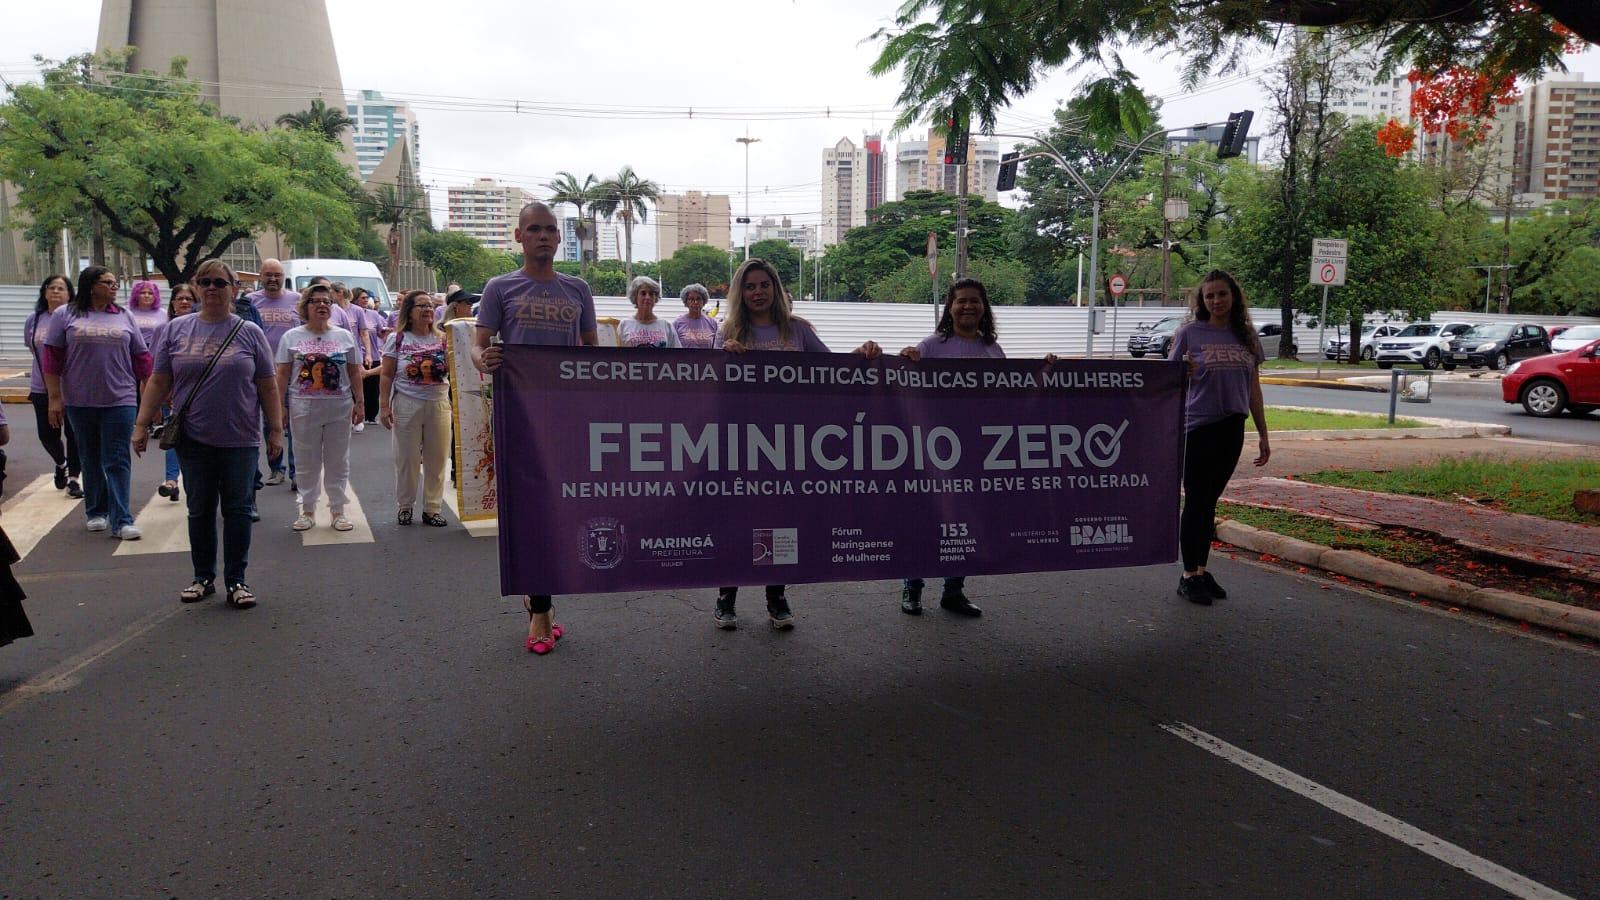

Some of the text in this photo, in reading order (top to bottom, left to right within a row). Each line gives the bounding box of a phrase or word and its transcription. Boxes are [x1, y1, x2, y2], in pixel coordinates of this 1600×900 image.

[515, 303, 578, 322] ZERO
[559, 360, 1145, 388] SECRETARIA DE POLITICAS PÚBLICAS PARA MULHERES
[589, 412, 1128, 472] FEMINICÍDIO ZERO
[562, 473, 1150, 498] NENHUMA VIOLÊNCIA CONTRA A MULHER DEVE SER TOLERADA
[831, 527, 862, 537] Fórum
[939, 523, 969, 538] 153
[1069, 523, 1134, 546] BRASIL
[640, 533, 715, 550] MARINGÁ
[831, 540, 894, 551] Maringaense
[940, 538, 977, 547] PATRULHA
[652, 549, 704, 558] PREFEITURA
[940, 546, 965, 555] MARIA
[831, 552, 891, 563] de Mulheres
[940, 554, 966, 562] PENHA
